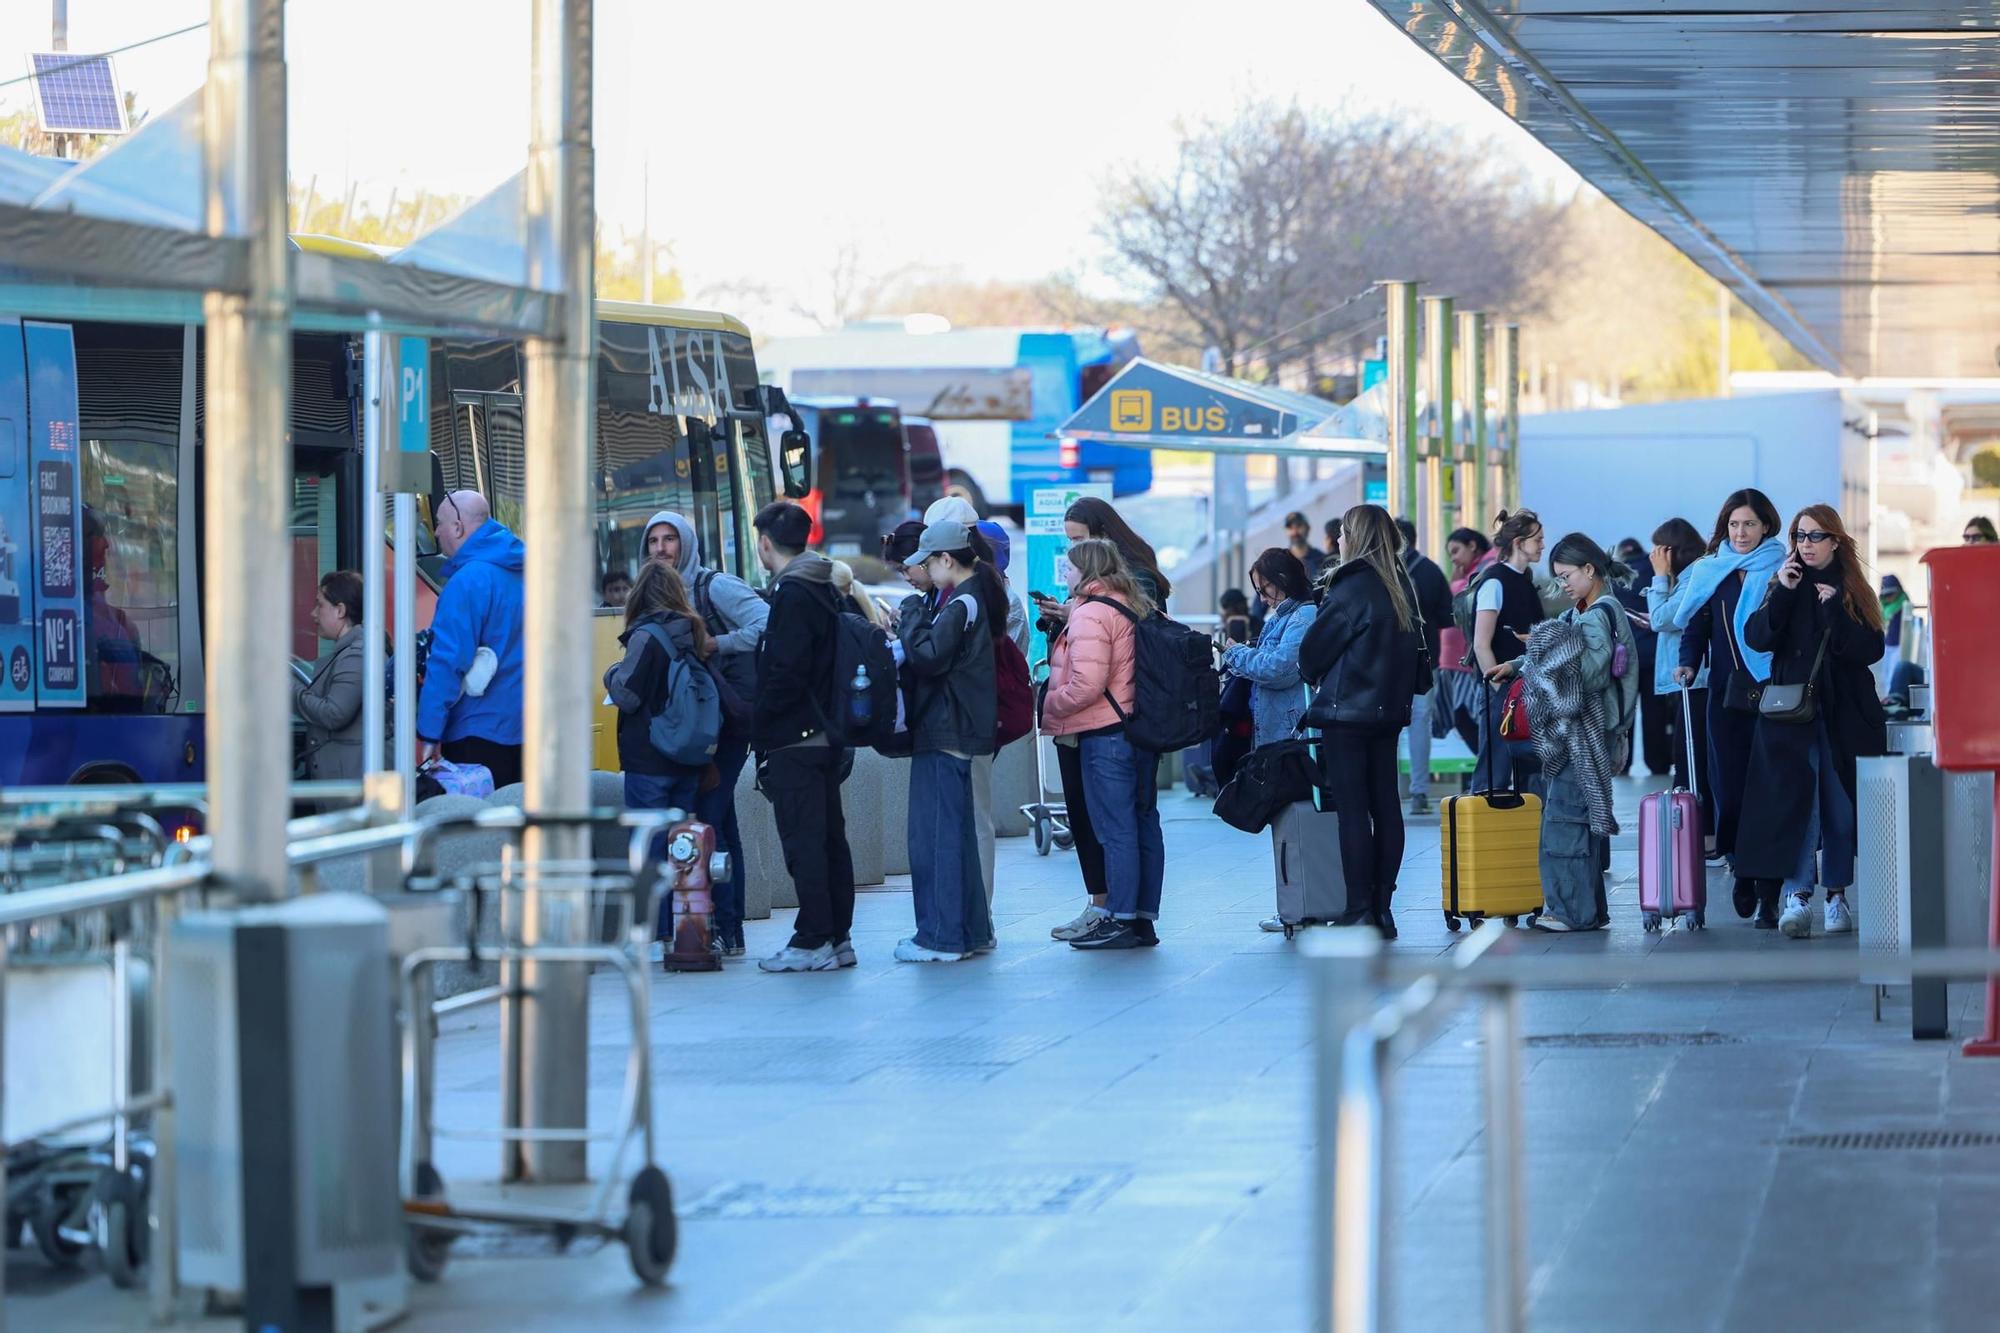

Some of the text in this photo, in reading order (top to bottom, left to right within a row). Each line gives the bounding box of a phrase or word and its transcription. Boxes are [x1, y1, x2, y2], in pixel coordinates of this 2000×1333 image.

[403, 367, 423, 423] P1
[1161, 407, 1226, 431] BUS
[41, 471, 57, 490] FAST
[41, 495, 71, 515] BOOKING
[48, 666, 74, 682] COMPANY
